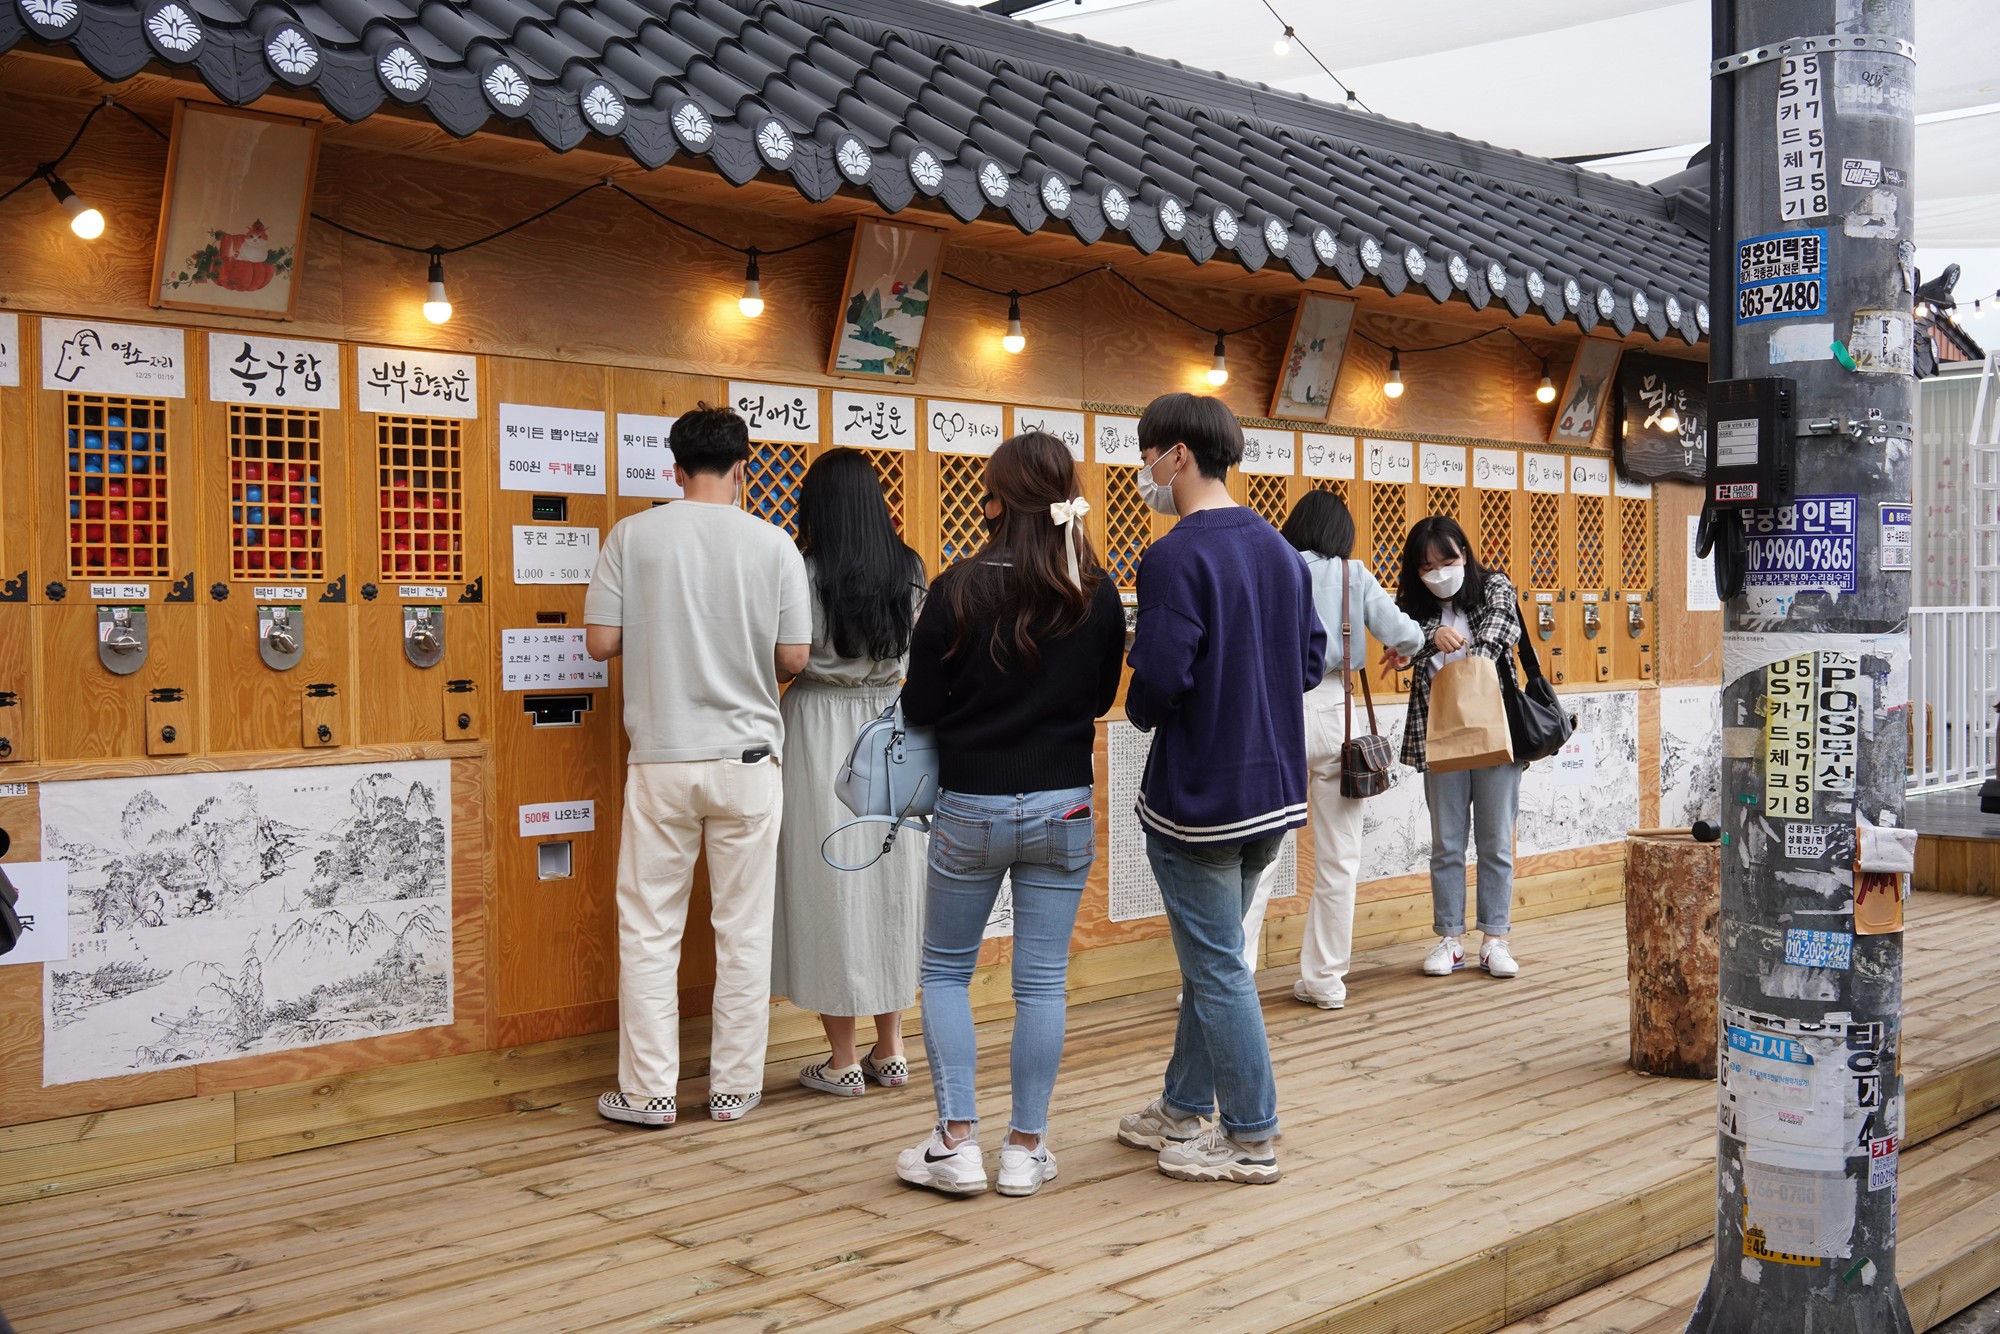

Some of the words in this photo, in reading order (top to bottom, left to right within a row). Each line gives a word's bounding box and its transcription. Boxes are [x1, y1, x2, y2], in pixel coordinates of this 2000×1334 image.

[1741, 238, 1799, 269] 영호인력
[1801, 236, 1819, 272] 잡부
[1783, 263, 1799, 275] 전문
[1740, 282, 1819, 317] 363-2480
[230, 342, 322, 396] 속궁합
[738, 395, 811, 430] 연애운
[844, 402, 907, 440] 재물운
[550, 428, 599, 444] 뽑아보살
[509, 460, 541, 473] 500원
[548, 462, 596, 476] 두개투입
[626, 468, 655, 480] 500원
[1741, 501, 1852, 533] 무궁화인력
[523, 532, 547, 546] 동전
[555, 532, 590, 547] 교환기
[560, 568, 579, 579] 500
[523, 635, 530, 643] 원
[542, 635, 564, 643] 오백원
[572, 634, 583, 643] 2개
[557, 653, 564, 661] 원
[572, 653, 584, 661] 5개
[524, 673, 531, 681] 원
[558, 672, 565, 680] 원
[570, 672, 584, 680] 10개
[1562, 759, 1584, 769] 버리는곳
[0, 784, 27, 795] 거함
[524, 811, 550, 824] 500원
[554, 807, 590, 821] 나오는곳
